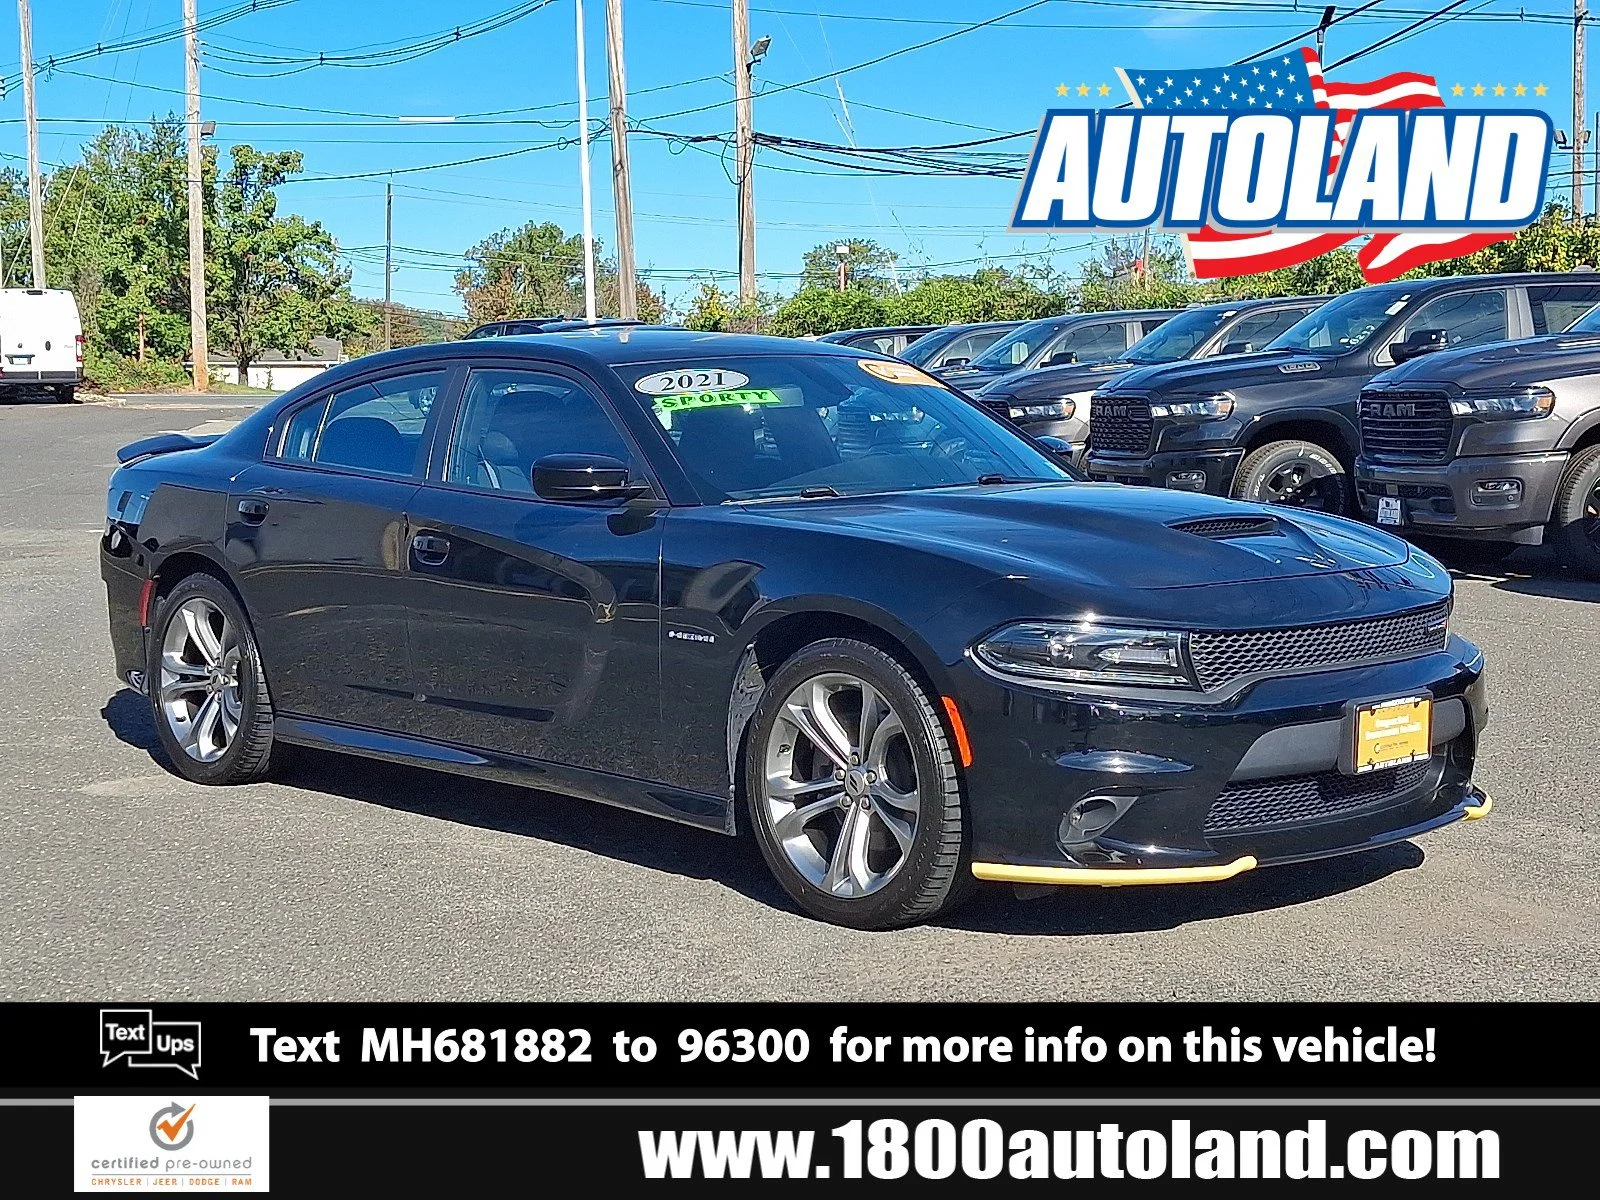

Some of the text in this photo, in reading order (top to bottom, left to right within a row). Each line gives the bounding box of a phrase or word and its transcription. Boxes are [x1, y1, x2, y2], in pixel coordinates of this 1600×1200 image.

[659, 372, 727, 392] 2021
[661, 391, 769, 408] SPORTY
[1095, 405, 1127, 417] RAM
[1370, 404, 1416, 417] RAM
